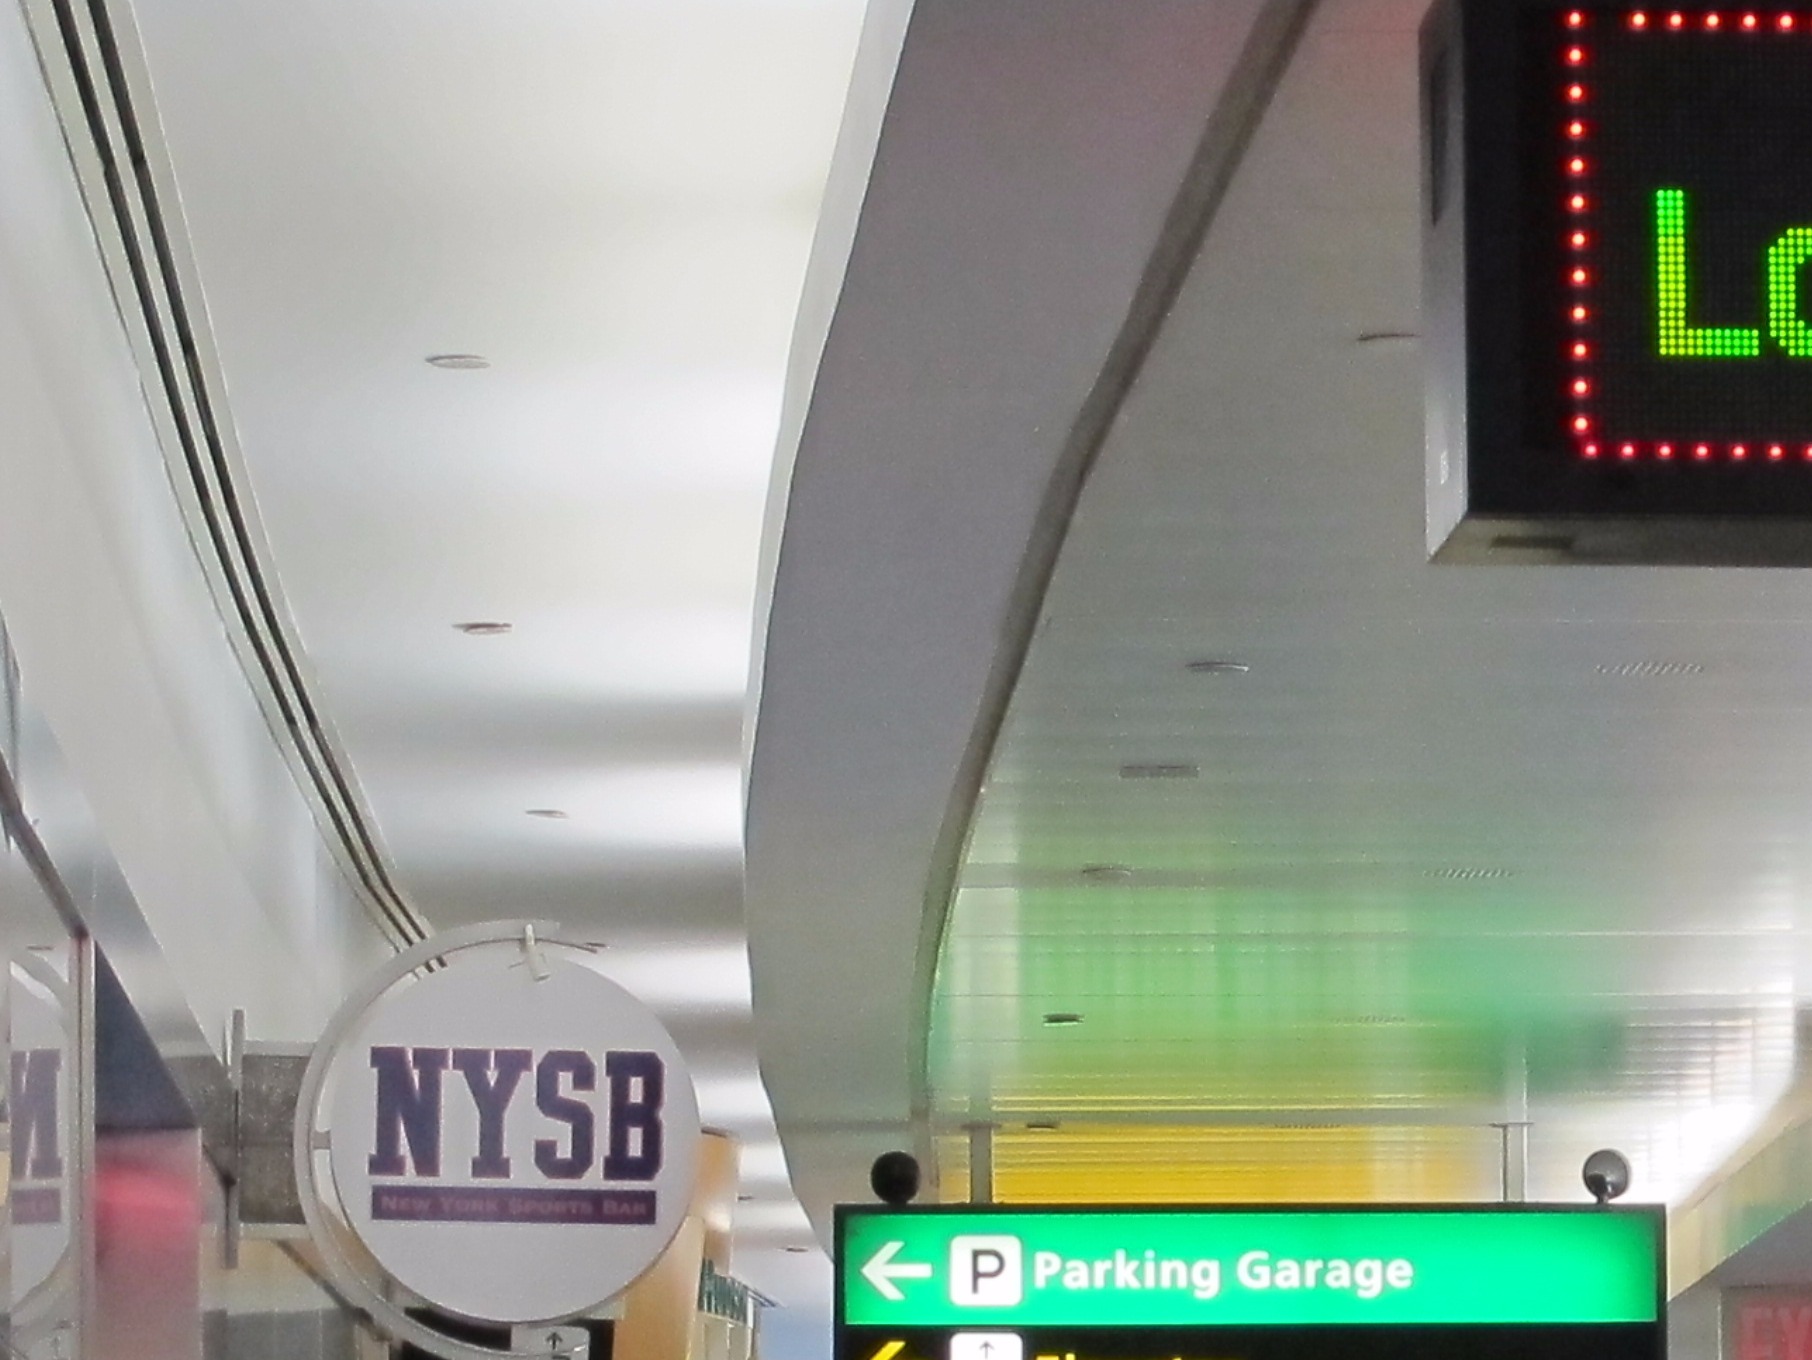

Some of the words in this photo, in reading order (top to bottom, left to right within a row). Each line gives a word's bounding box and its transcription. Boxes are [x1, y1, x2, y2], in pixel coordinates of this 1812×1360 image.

[369, 1046, 664, 1180] NYSB
[970, 1248, 1006, 1294] P
[1032, 1248, 1221, 1299] Parking
[1236, 1249, 1415, 1299] Garage
